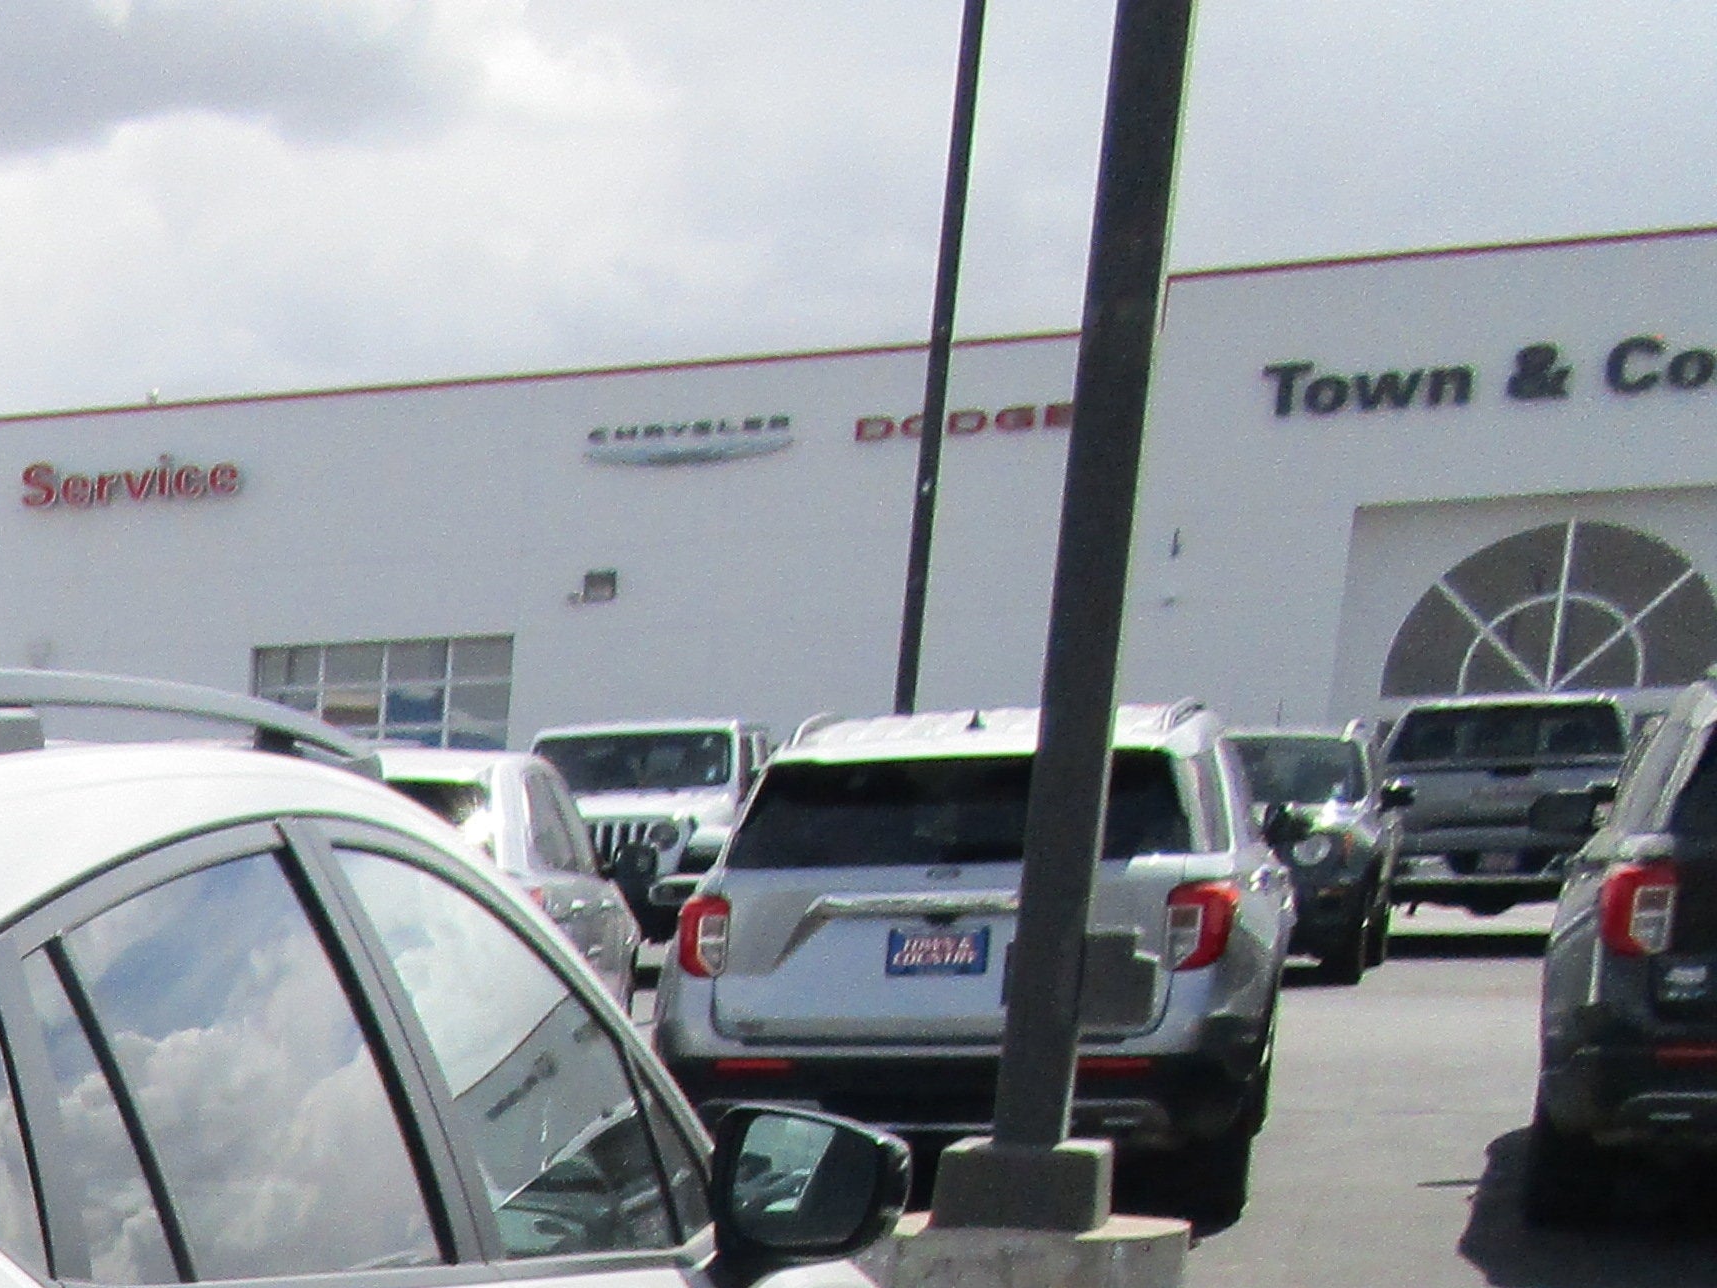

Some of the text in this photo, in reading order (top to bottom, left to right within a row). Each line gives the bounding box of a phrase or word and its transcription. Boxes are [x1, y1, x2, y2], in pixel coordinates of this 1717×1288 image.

[1263, 360, 1476, 418] Town
[1506, 341, 1574, 400] &
[587, 413, 790, 443] CHRYSLER
[21, 453, 239, 507] Service
